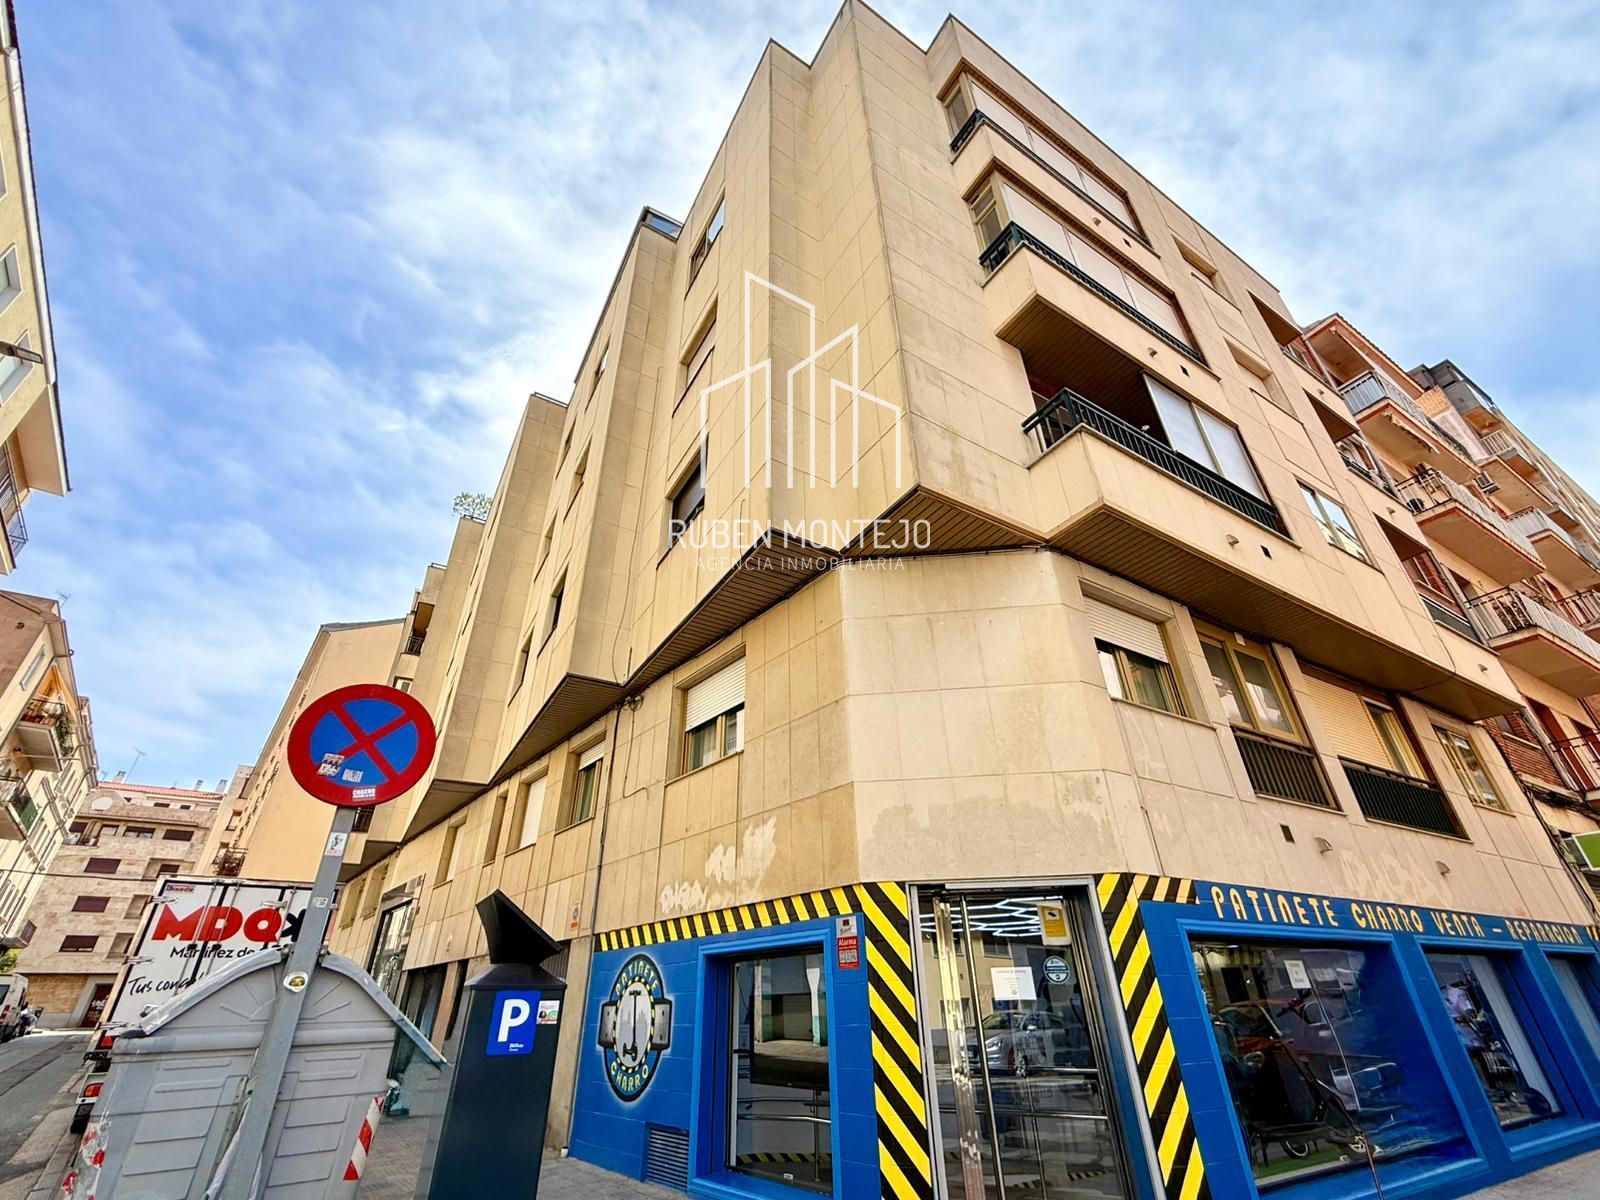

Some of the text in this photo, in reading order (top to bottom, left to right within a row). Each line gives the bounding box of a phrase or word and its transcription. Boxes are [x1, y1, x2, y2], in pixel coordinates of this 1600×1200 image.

[1211, 886, 1339, 927] PATINETE
[1351, 902, 1424, 933] CHARRO
[1430, 911, 1485, 938] VENTA
[1505, 919, 1584, 945] REPARACION
[128, 976, 152, 996] Tus
[615, 960, 659, 996] PATINETE
[497, 998, 530, 1042] P
[611, 1062, 649, 1093] CHARRO
